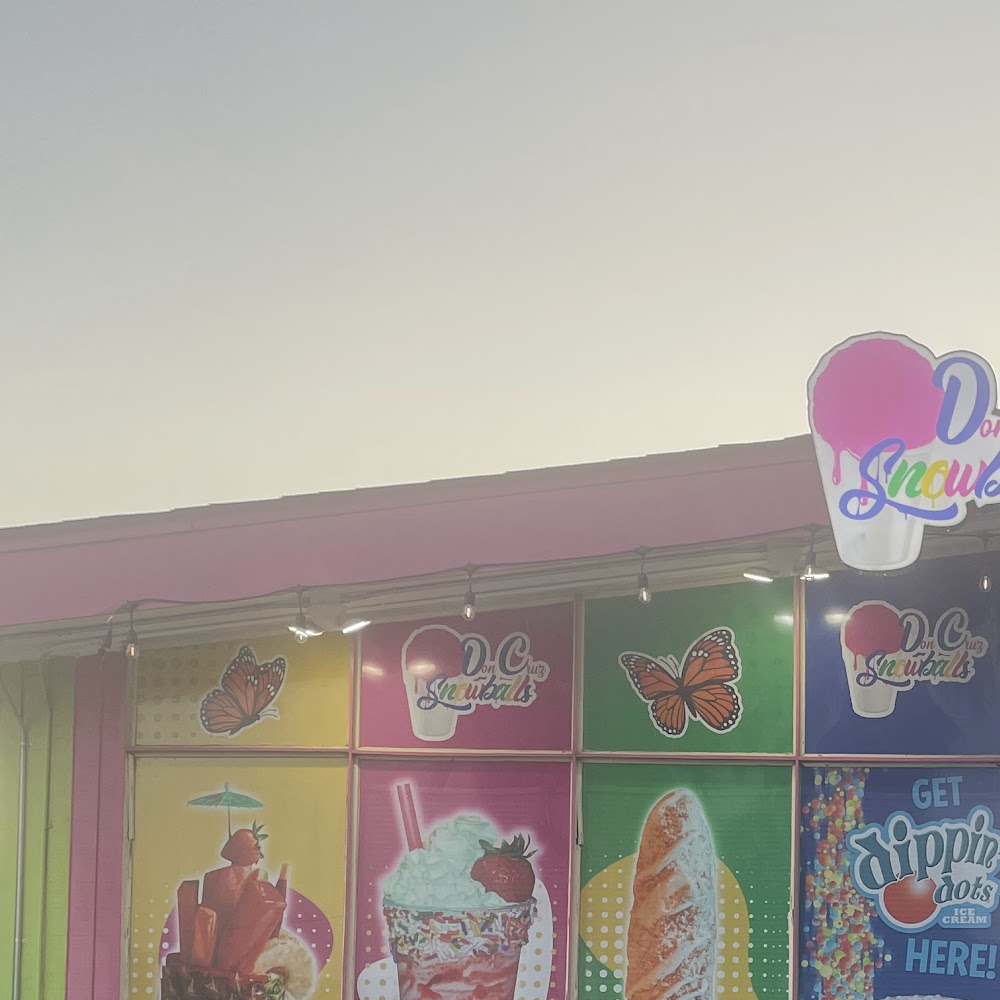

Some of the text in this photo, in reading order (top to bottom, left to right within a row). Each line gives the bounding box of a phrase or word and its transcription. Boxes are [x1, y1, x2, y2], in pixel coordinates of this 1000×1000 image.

[899, 611, 985, 654] Don Cruz
[460, 635, 546, 678] Don Cruz
[856, 650, 972, 687] Snowballs
[416, 673, 533, 711] Snowballs
[912, 775, 963, 810] GET
[933, 874, 993, 904] dots
[941, 915, 988, 924] CREAM
[953, 908, 976, 916] ICE
[905, 937, 997, 980] HERE!
